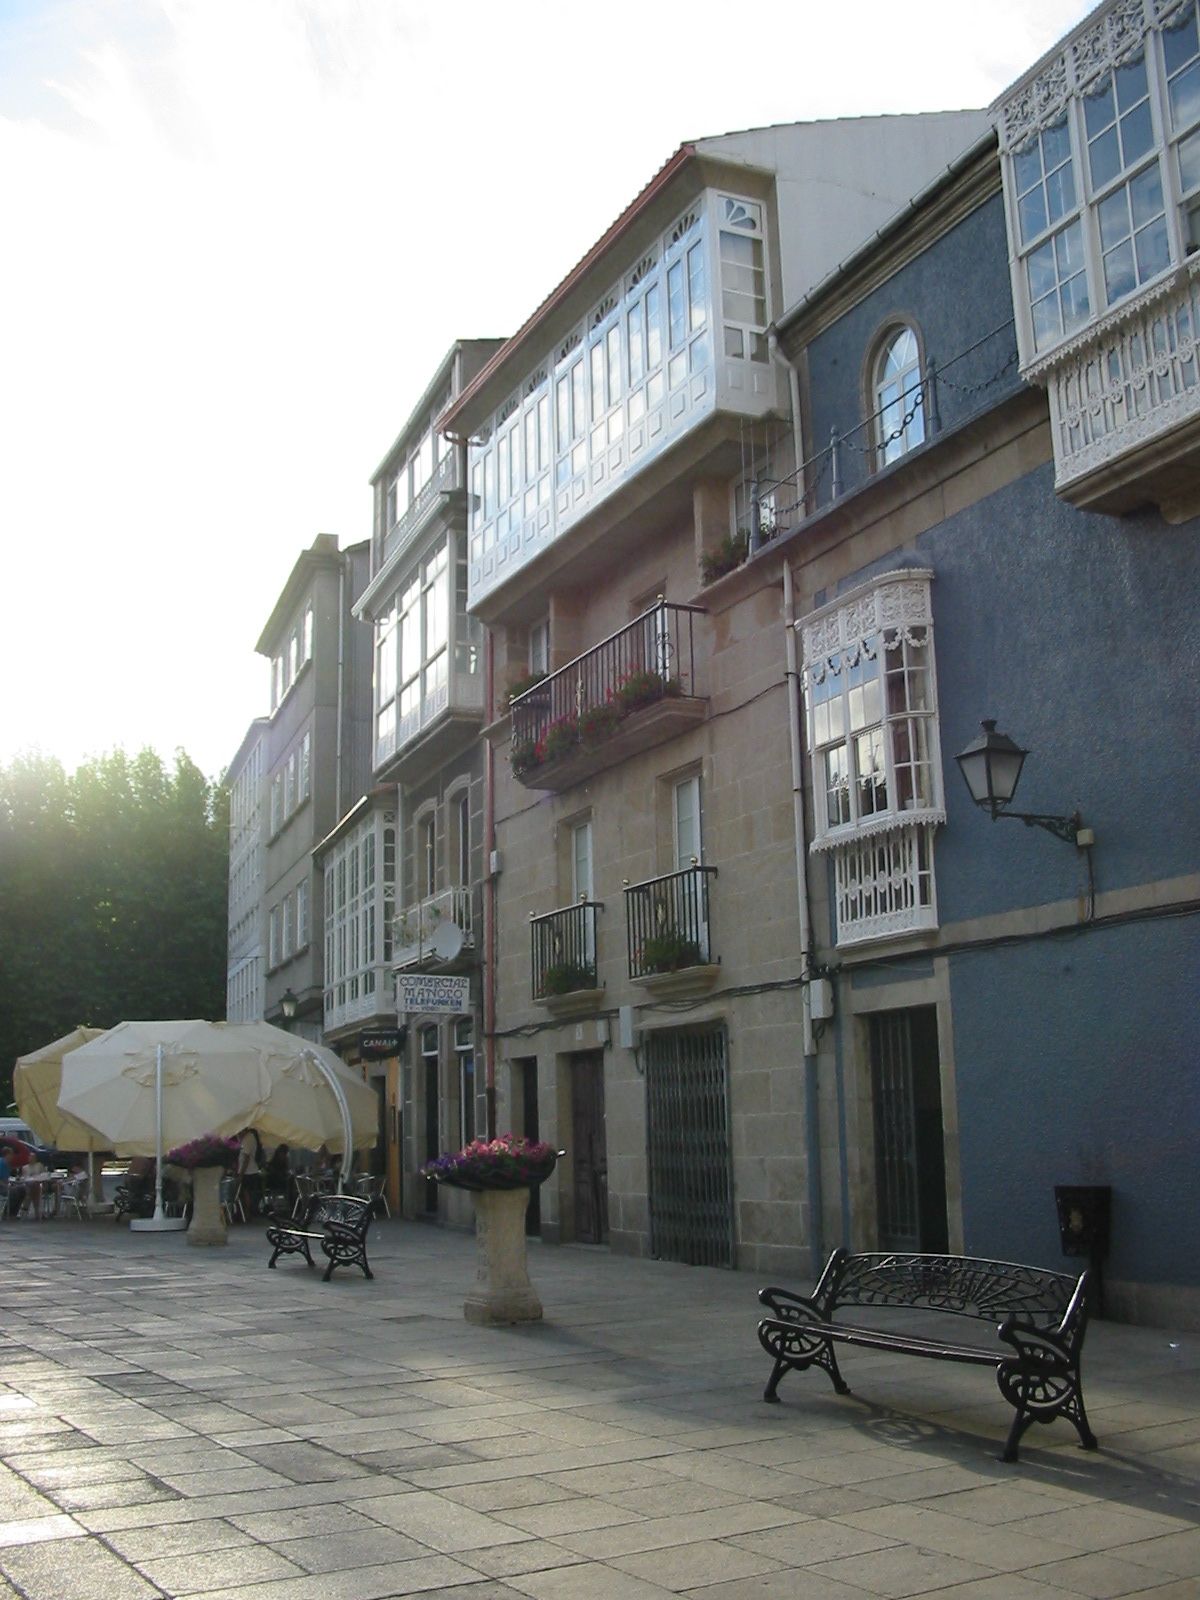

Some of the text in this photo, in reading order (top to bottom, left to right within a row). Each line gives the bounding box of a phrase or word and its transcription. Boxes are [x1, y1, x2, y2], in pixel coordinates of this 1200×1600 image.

[400, 976, 468, 988] COMERCIAL
[405, 987, 463, 999] MANOLO
[405, 998, 463, 1006] TELEFUNKEN
